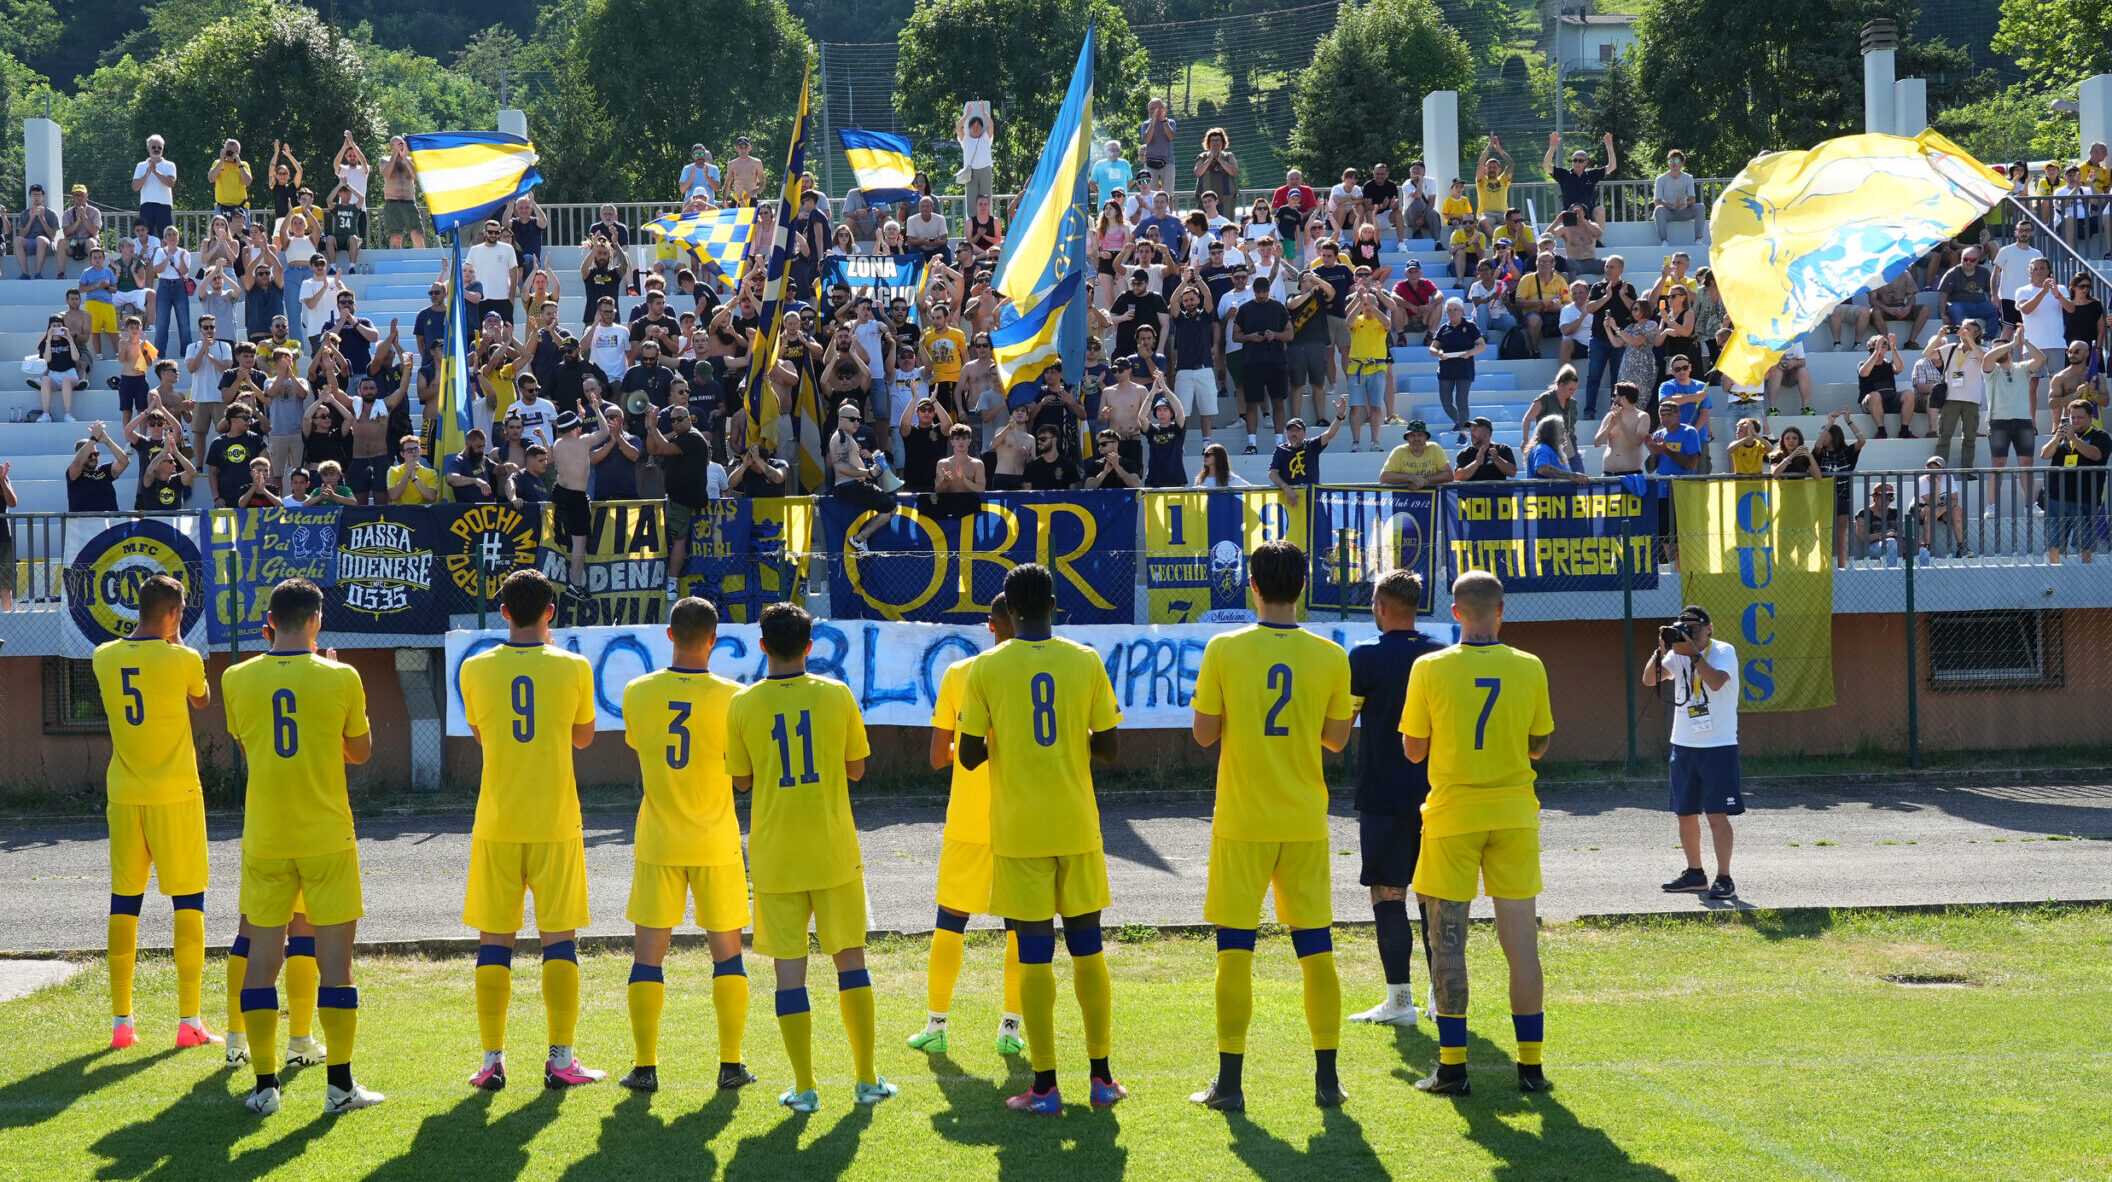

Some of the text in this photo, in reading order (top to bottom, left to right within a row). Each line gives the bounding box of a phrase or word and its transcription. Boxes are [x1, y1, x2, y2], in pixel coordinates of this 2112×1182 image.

[339, 216, 351, 229] 34
[846, 256, 898, 278] ZONA
[263, 506, 339, 525] Distanti
[449, 505, 524, 542] POCHI
[1167, 502, 1289, 546] 1 9
[1457, 493, 1642, 521] NOI DI SAN BIAGIO
[123, 543, 159, 556] MFC
[263, 534, 290, 551] Dai
[350, 524, 411, 553] BASSA
[1450, 535, 1652, 578] TUTTI PRESENTI
[261, 555, 326, 584] Giochi
[843, 503, 1117, 622] QBR
[1149, 563, 1208, 582] VECCHIE
[346, 583, 408, 610] 0535
[549, 592, 661, 628] ERVIA
[1210, 611, 1246, 623] Modena
[120, 667, 145, 726] 5
[510, 674, 535, 743] 9
[1030, 672, 1057, 747] 8
[1264, 662, 1293, 736] 2
[1474, 677, 1501, 750] 7
[272, 687, 298, 759] 6
[665, 700, 692, 770] 3
[771, 709, 820, 788] 11
